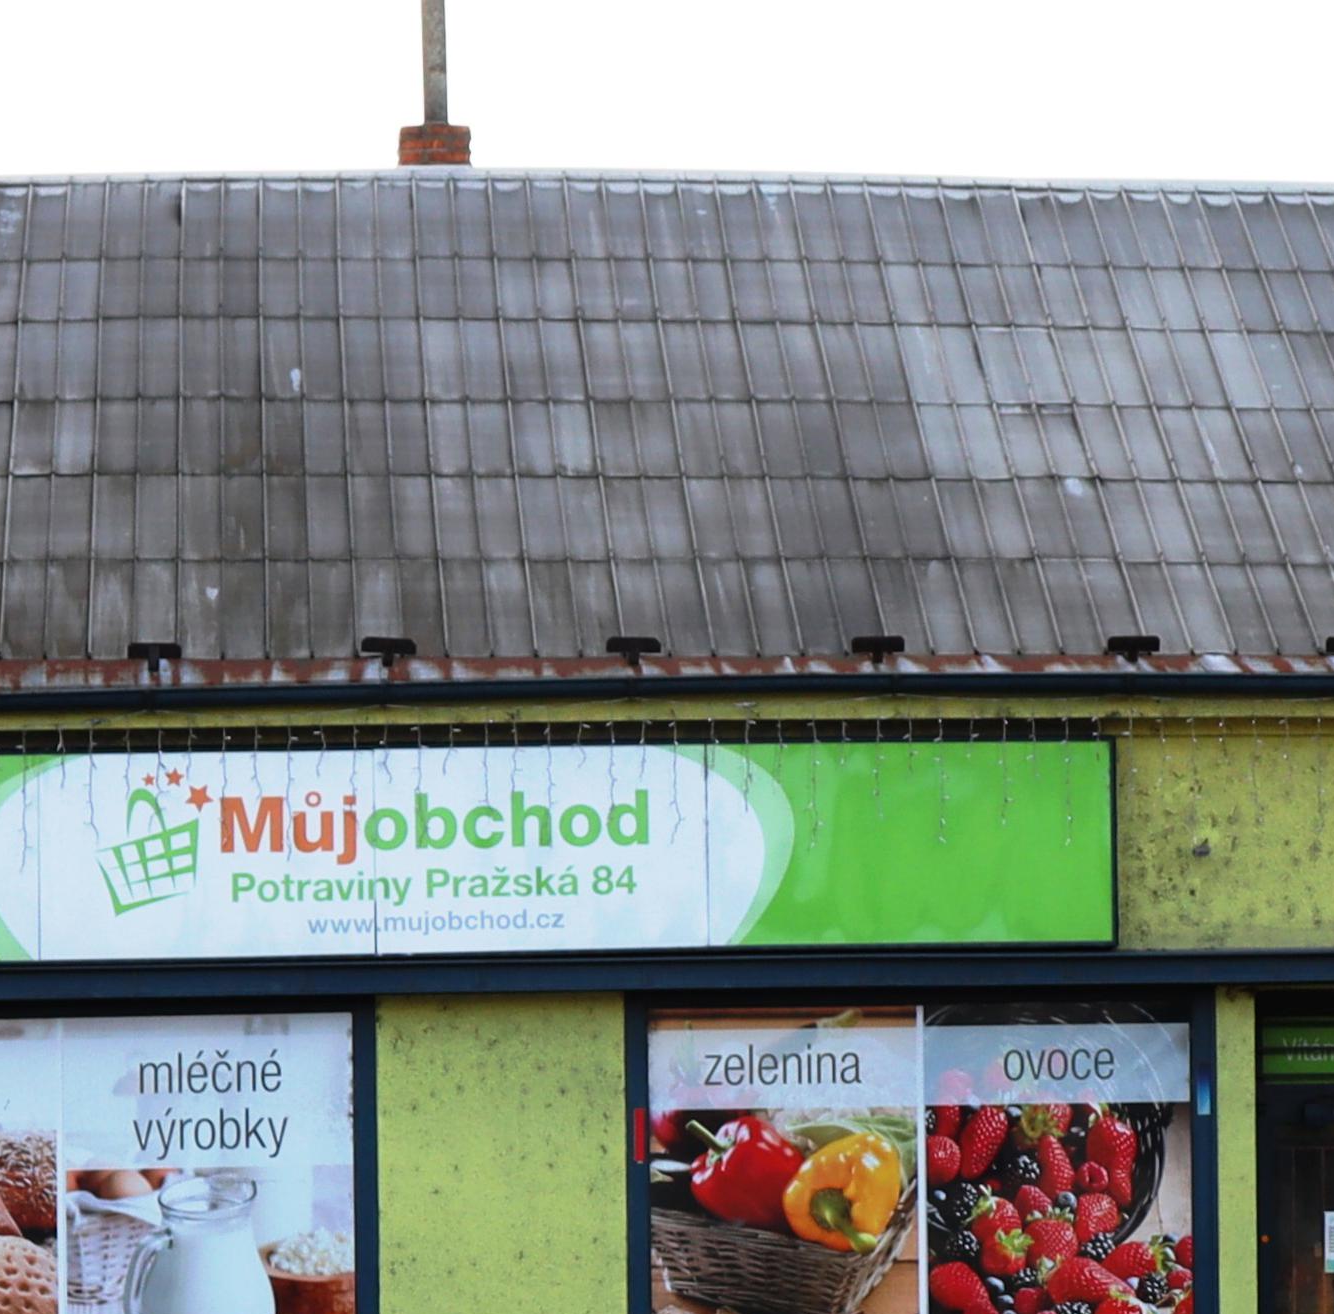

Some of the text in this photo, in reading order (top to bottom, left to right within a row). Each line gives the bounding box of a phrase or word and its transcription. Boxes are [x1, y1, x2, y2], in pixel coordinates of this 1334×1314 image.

[219, 789, 650, 866] Můjobchod
[231, 866, 637, 907] Potraviny Pražská 84
[307, 908, 565, 936] www.mujobchod.cz
[138, 1049, 282, 1095] mléčné
[703, 1044, 862, 1087] zelenina
[1003, 1041, 1115, 1081] ovoce
[133, 1107, 288, 1159] výrobky
